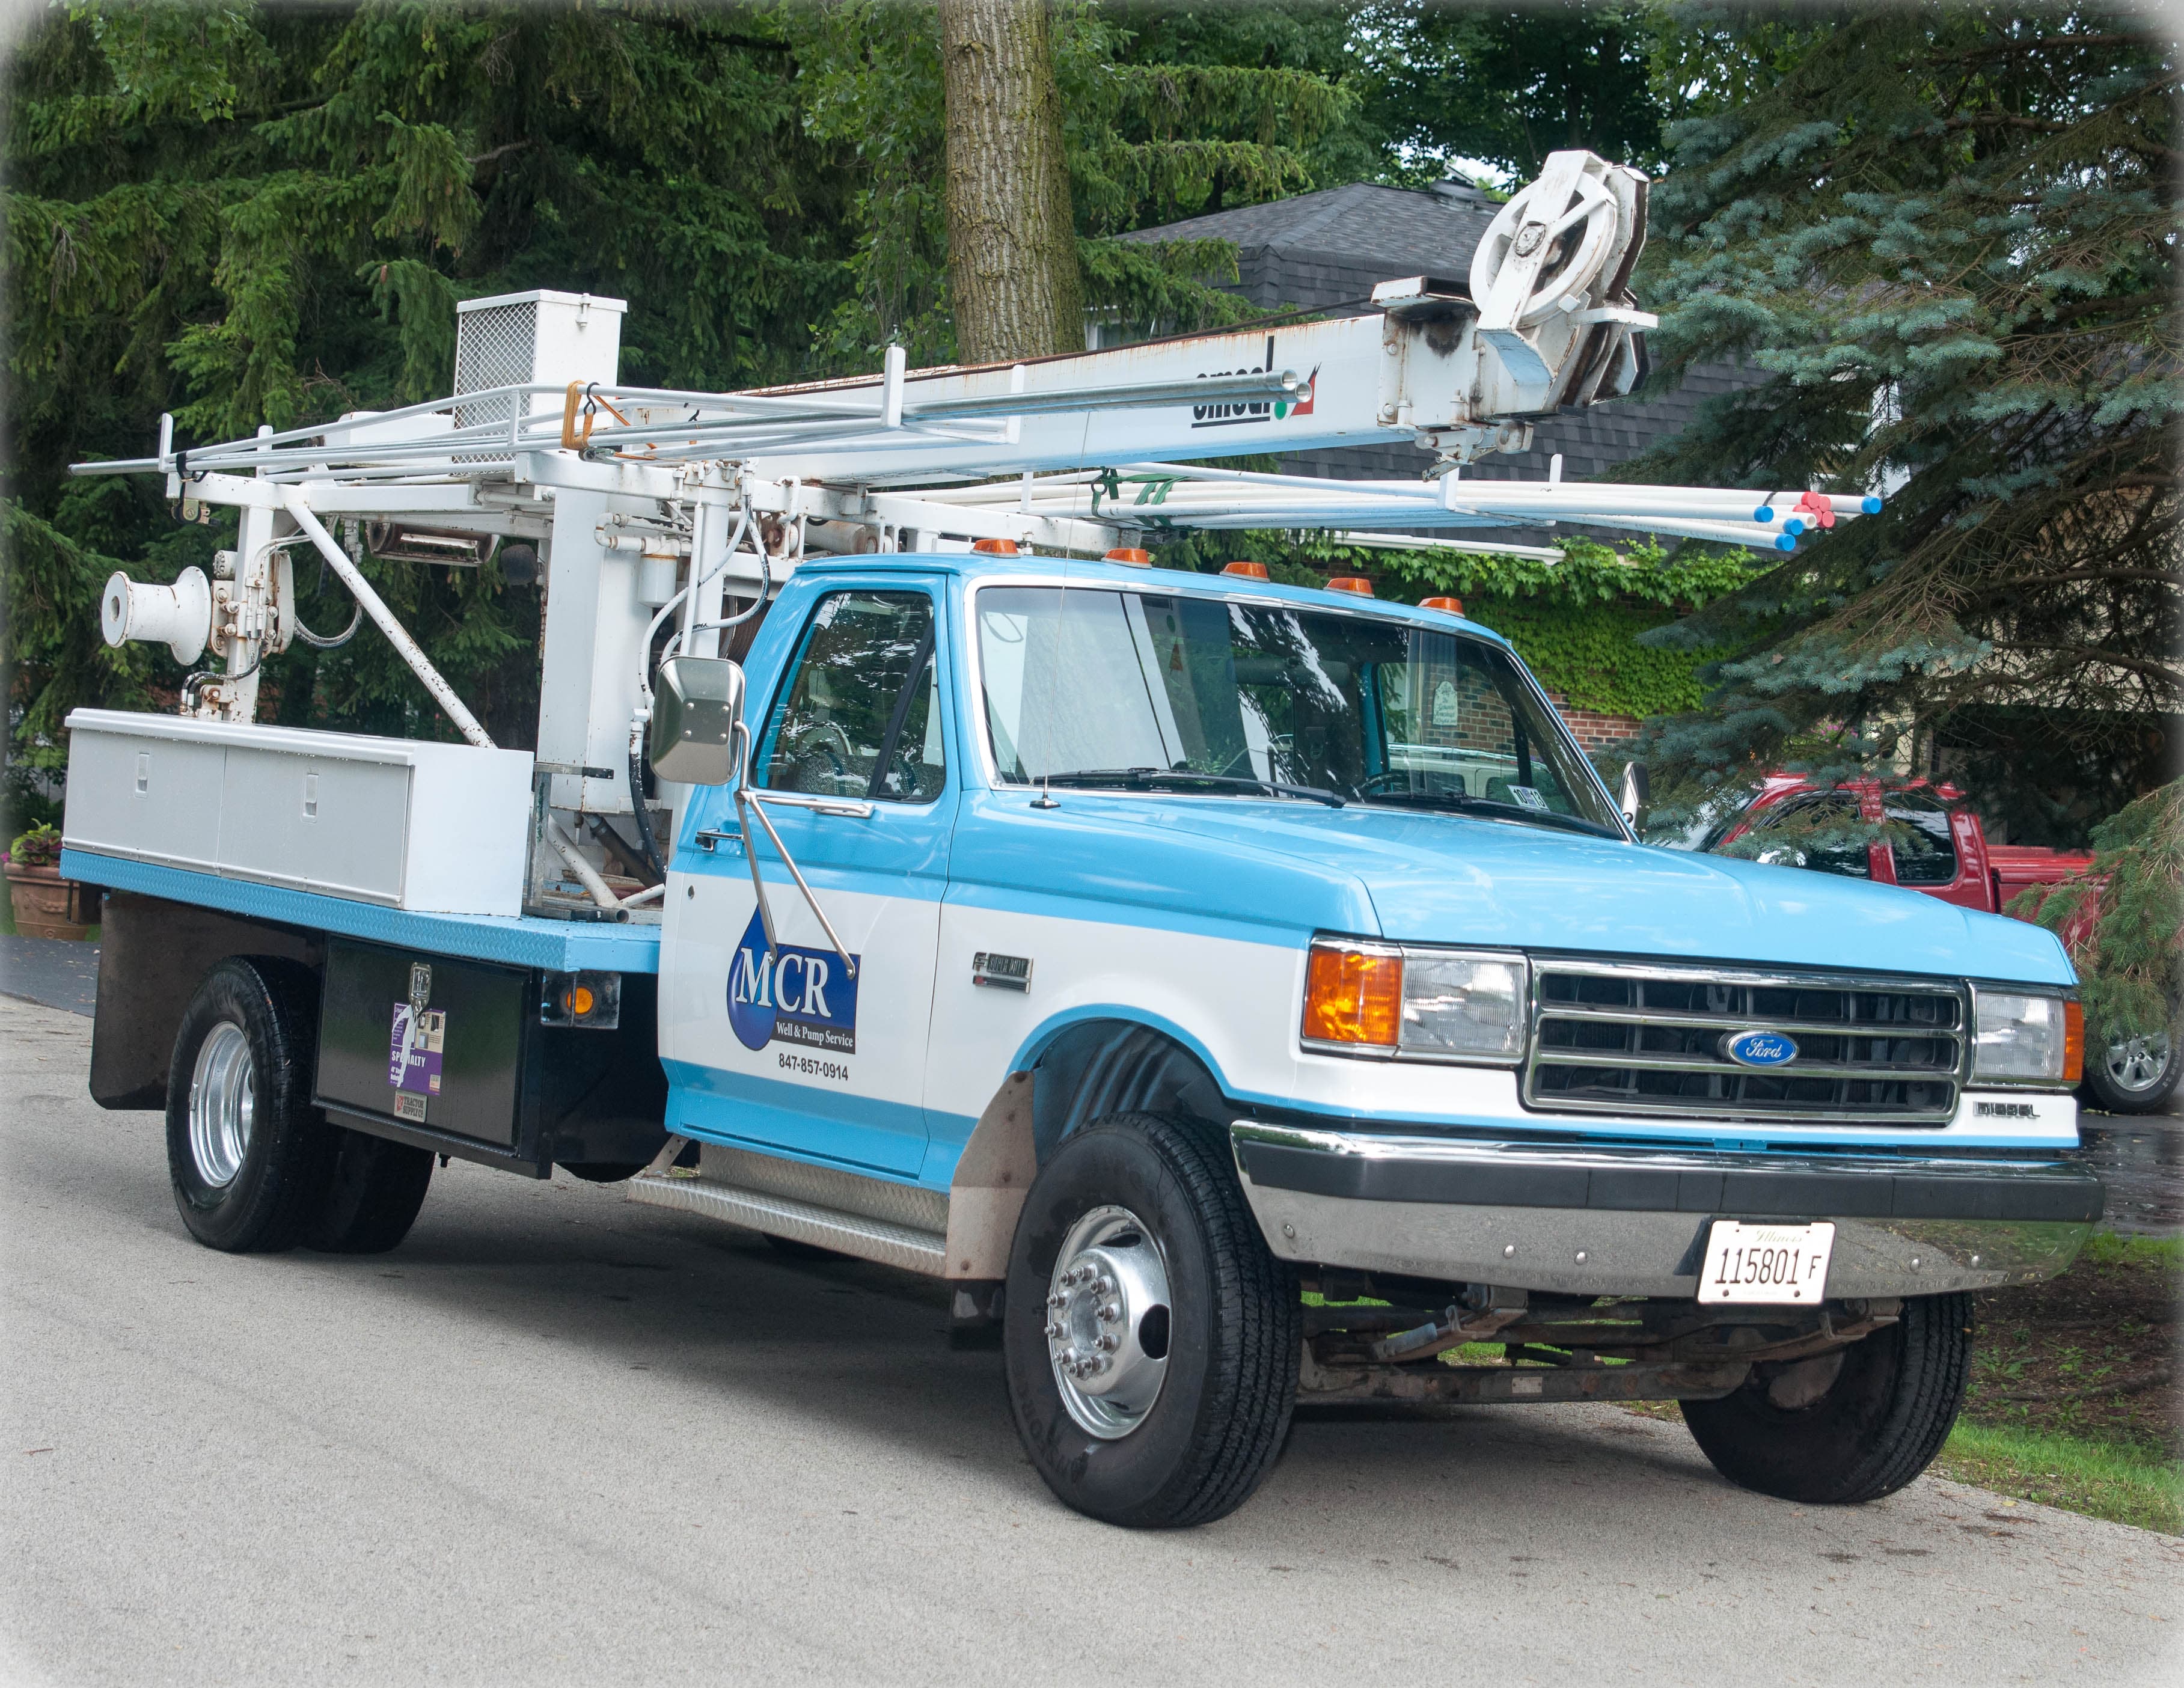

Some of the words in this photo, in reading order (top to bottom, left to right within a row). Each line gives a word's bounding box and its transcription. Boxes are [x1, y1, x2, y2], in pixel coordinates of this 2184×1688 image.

[1513, 789, 1528, 804] 10
[1530, 790, 1546, 807] 13
[735, 947, 832, 1018] MCR
[776, 1021, 794, 1037] Well
[794, 1025, 801, 1038] &
[802, 1027, 824, 1046] Pump
[825, 1030, 853, 1047] Service
[1745, 1038, 1782, 1059] Ford
[778, 1053, 848, 1081] 847-857-0914
[403, 1105, 419, 1117] SUPPLY
[404, 1096, 424, 1109] TRACTOR
[1755, 1229, 1803, 1243] Illinois
[1714, 1247, 1800, 1285] 115801
[1808, 1255, 1822, 1279] F
